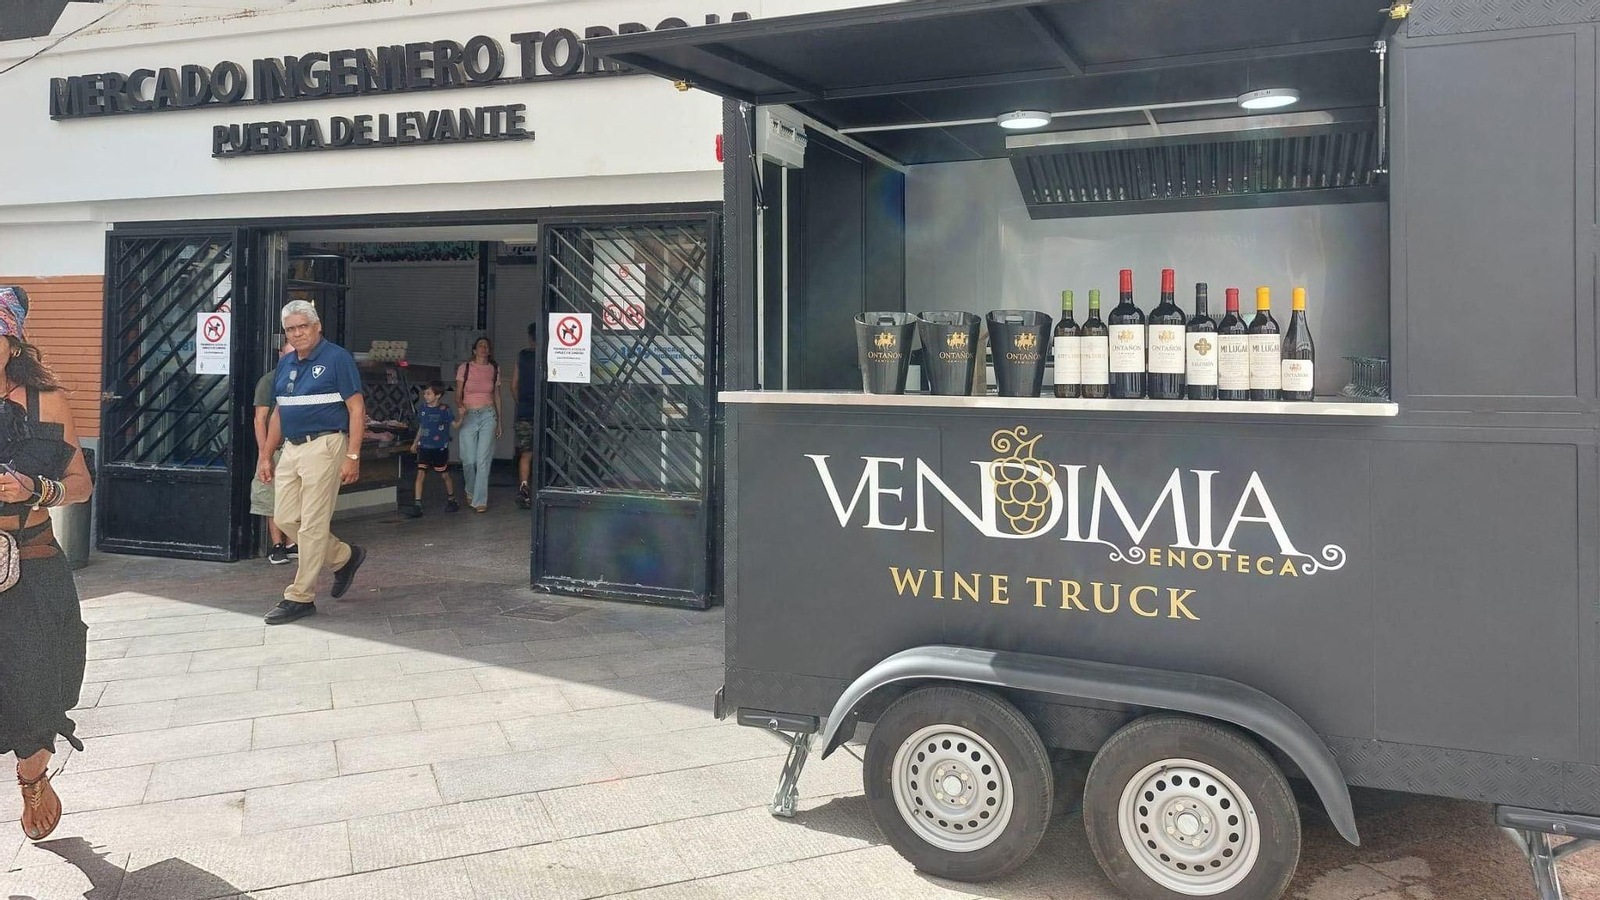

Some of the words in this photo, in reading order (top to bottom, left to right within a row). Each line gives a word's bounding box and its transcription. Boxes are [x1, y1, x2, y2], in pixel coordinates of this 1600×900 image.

[50, 60, 247, 115] MERCADO
[253, 35, 505, 101] INGENIERO
[212, 119, 324, 153] PUERTA
[330, 115, 373, 146] DE
[379, 104, 527, 142] LEVANTE
[804, 453, 1306, 556] VENDIMIA
[1150, 547, 1299, 578] ENOTECA
[888, 566, 1010, 605] WINE
[1025, 576, 1201, 621] TRUCK
